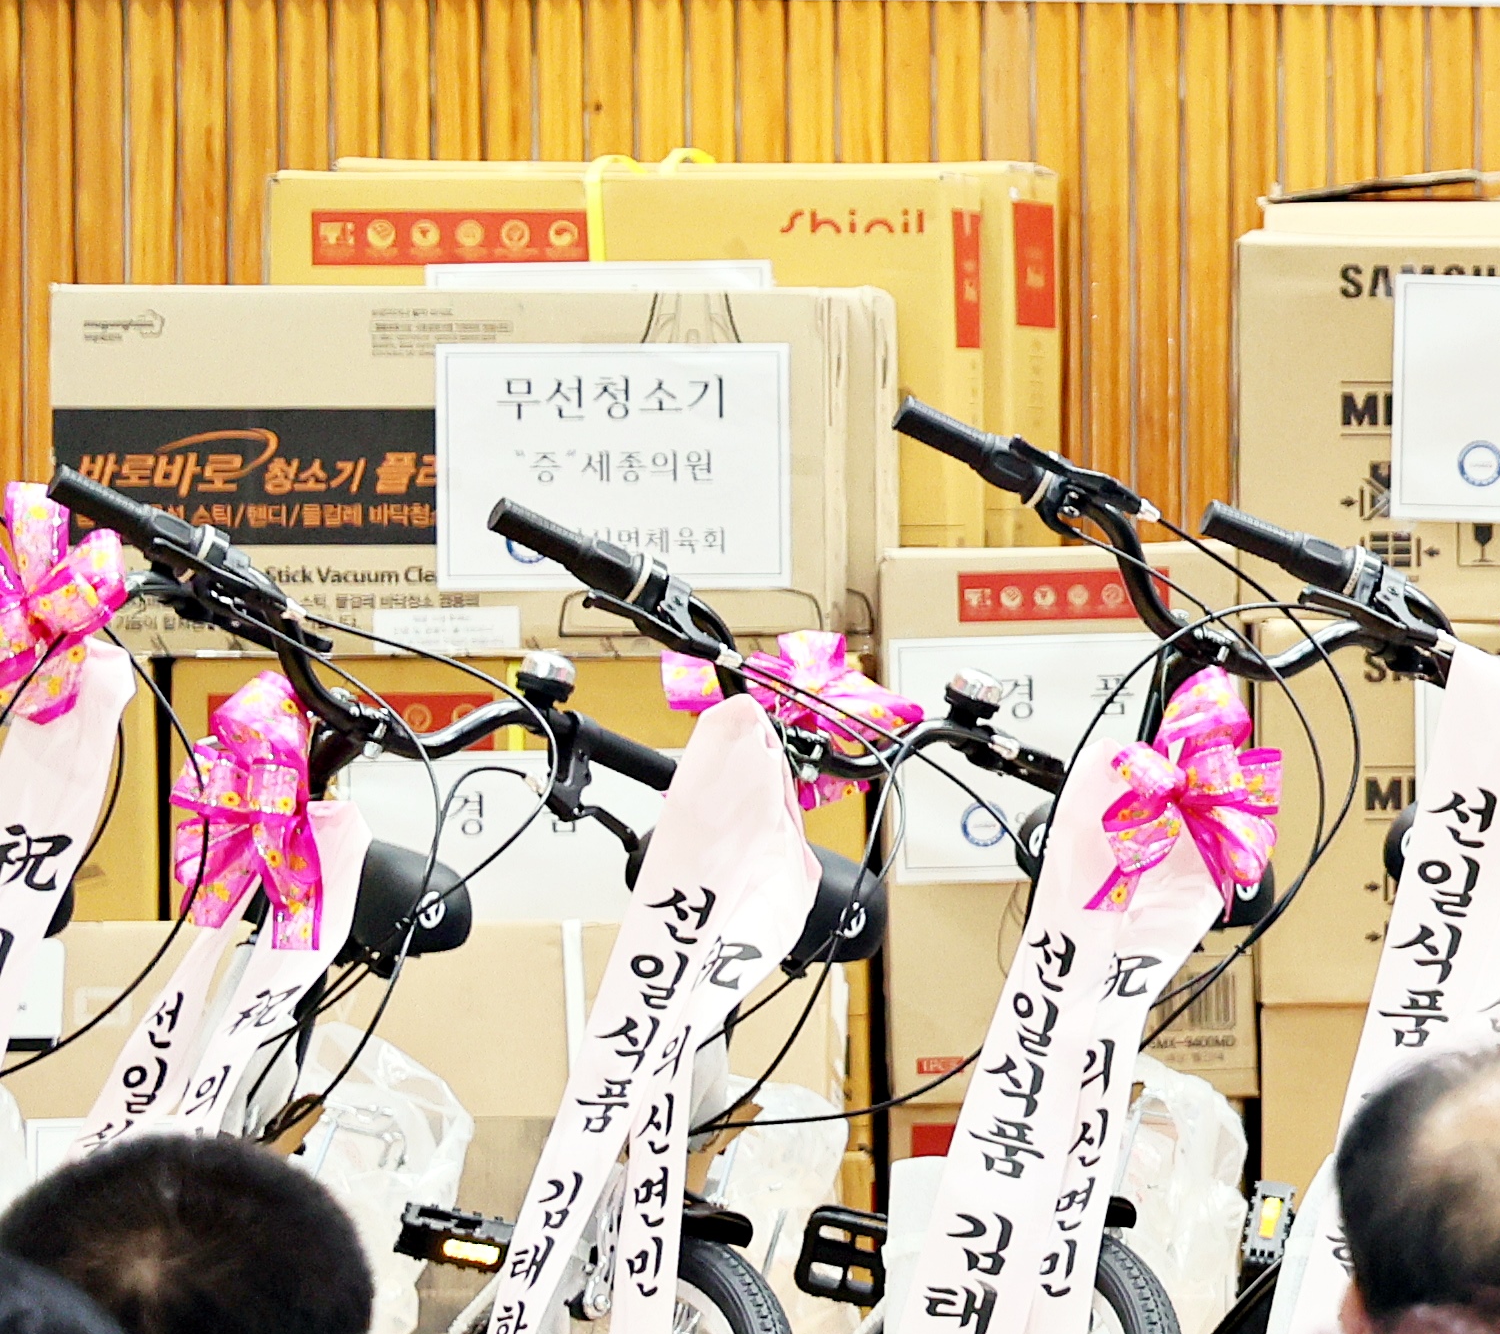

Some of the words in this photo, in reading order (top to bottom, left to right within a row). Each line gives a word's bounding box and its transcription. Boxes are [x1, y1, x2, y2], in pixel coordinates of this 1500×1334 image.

[262, 457, 367, 494] 청소기
[496, 374, 725, 421] 무선청소기
[319, 567, 399, 585] Vacuum
[575, 885, 717, 1134] 선일식품
[1377, 786, 1499, 1048] 선일식품
[626, 1023, 692, 1298] 의신면민
[968, 929, 1078, 1179] 선일식품
